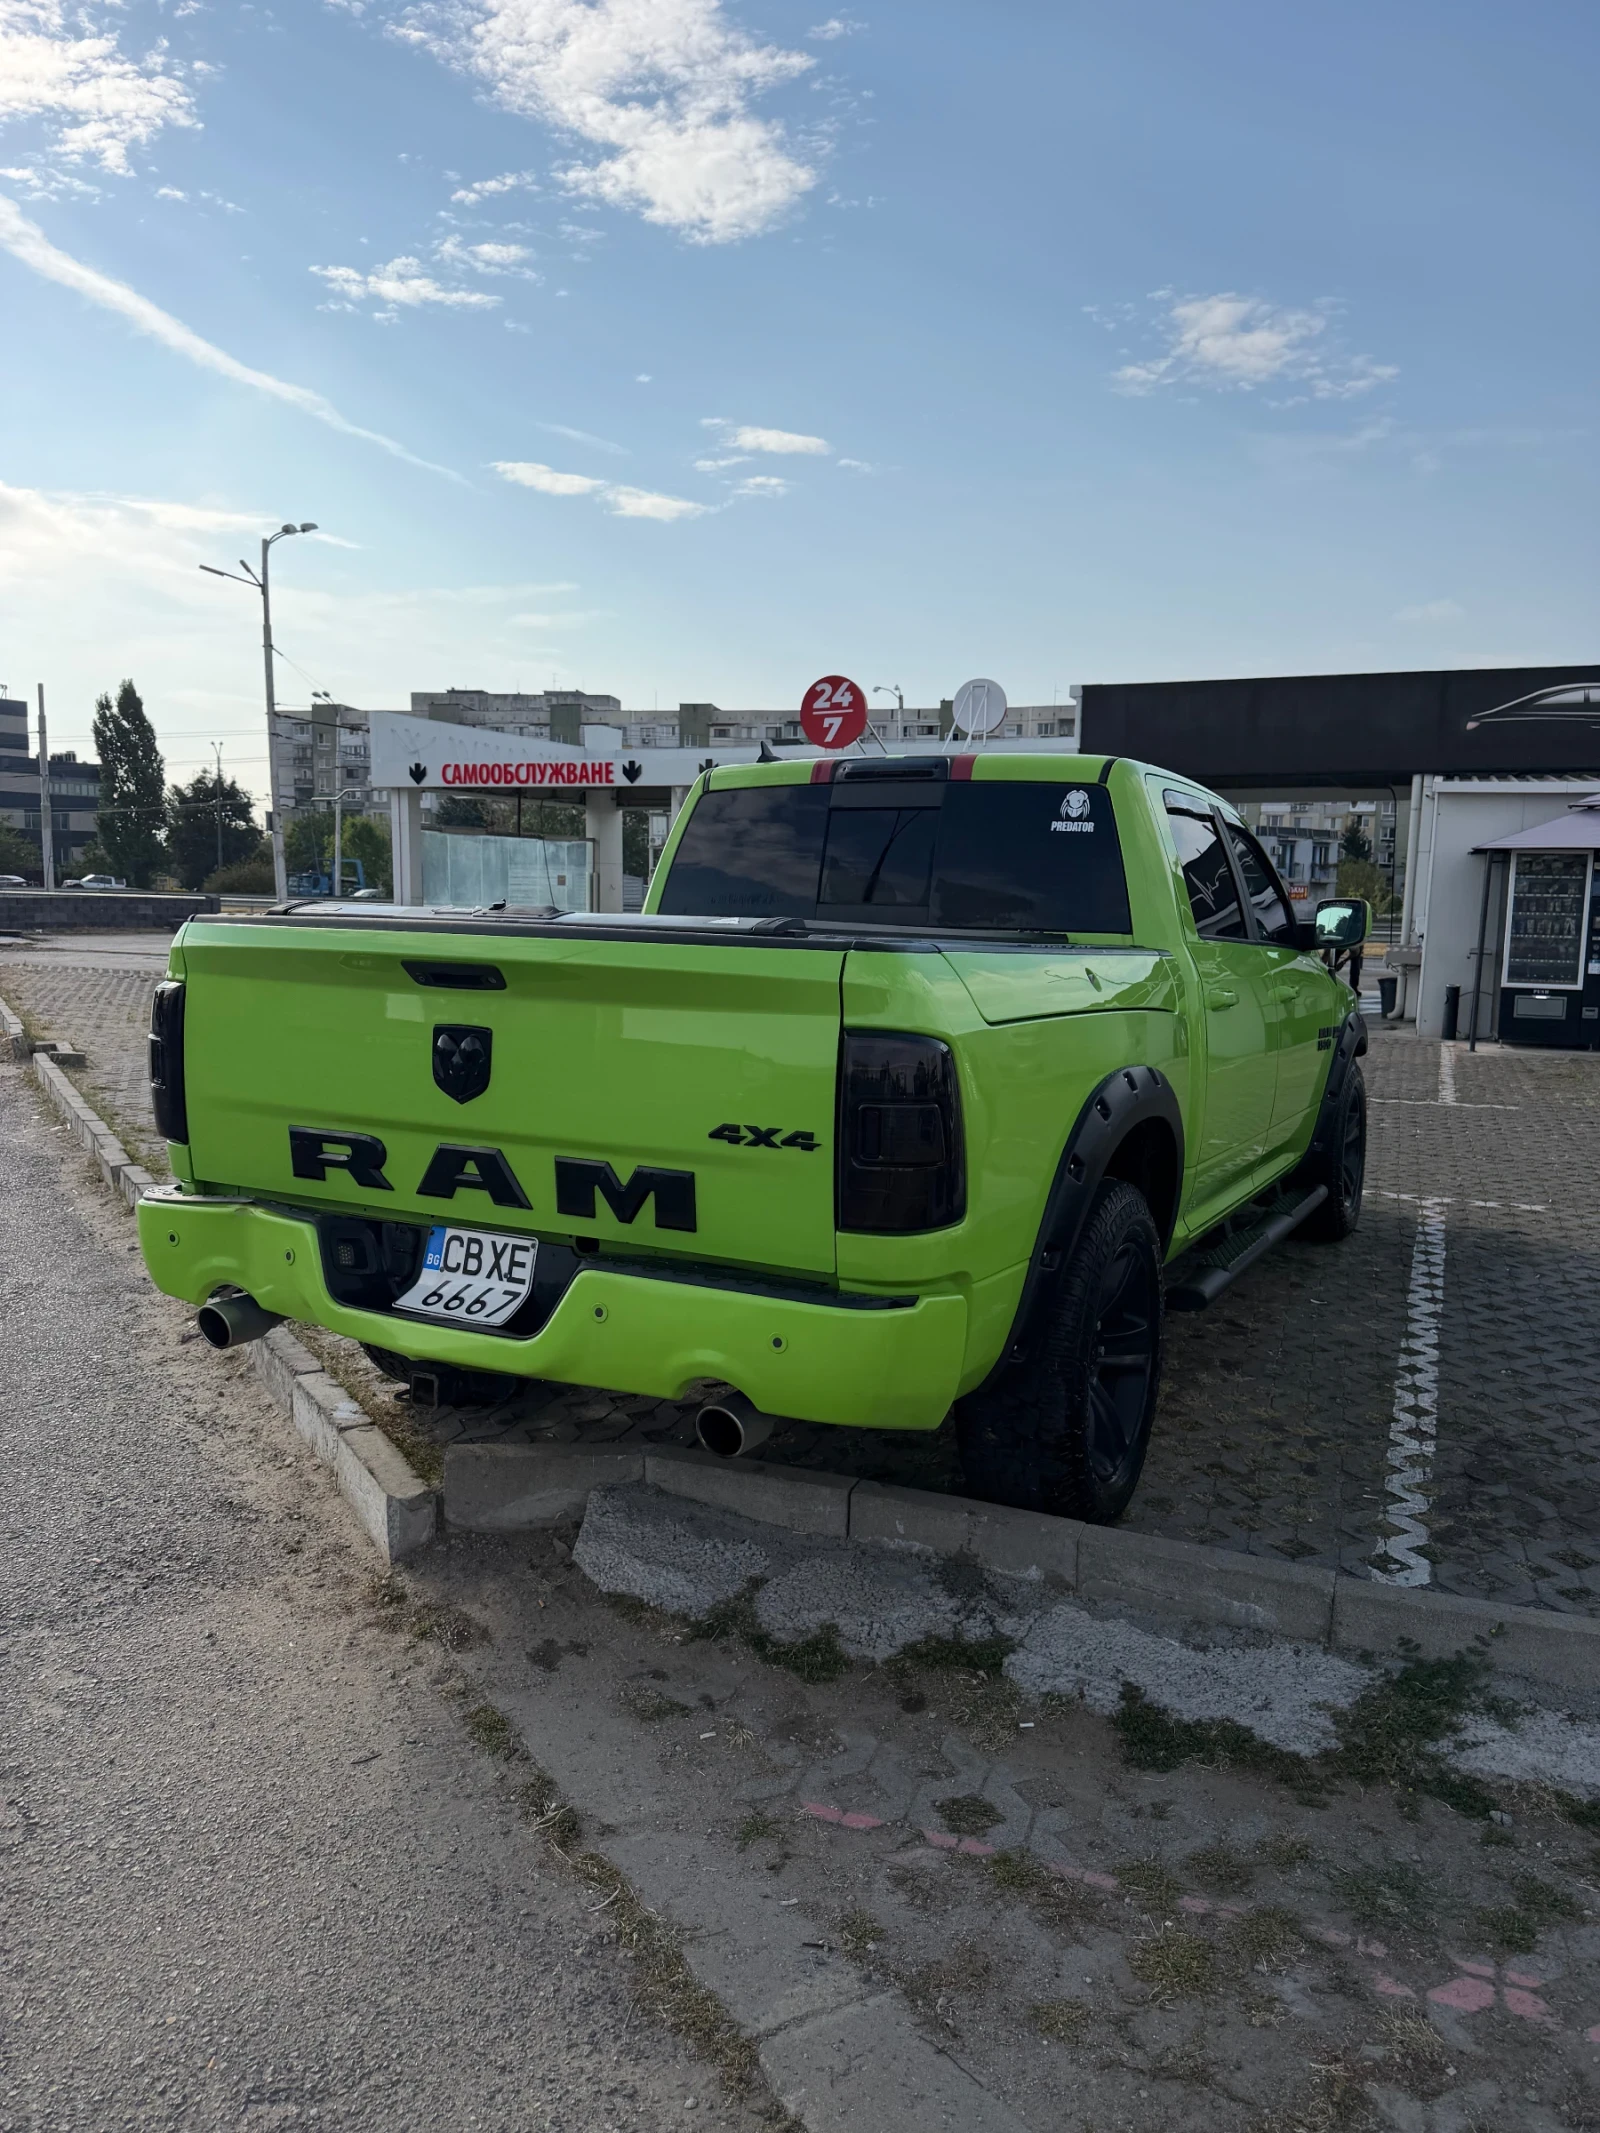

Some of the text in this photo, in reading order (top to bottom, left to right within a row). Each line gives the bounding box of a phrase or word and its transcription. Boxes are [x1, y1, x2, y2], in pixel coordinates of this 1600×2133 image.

[813, 681, 854, 709] 24
[823, 716, 843, 743] 7
[441, 761, 615, 785] САМООБСЛУЖВАНЕ
[1051, 821, 1095, 833] PREDATOR
[707, 1122, 823, 1152] 4X4
[288, 1124, 698, 1233] RAM
[426, 1253, 440, 1266] BG
[421, 1280, 522, 1318] 6667
